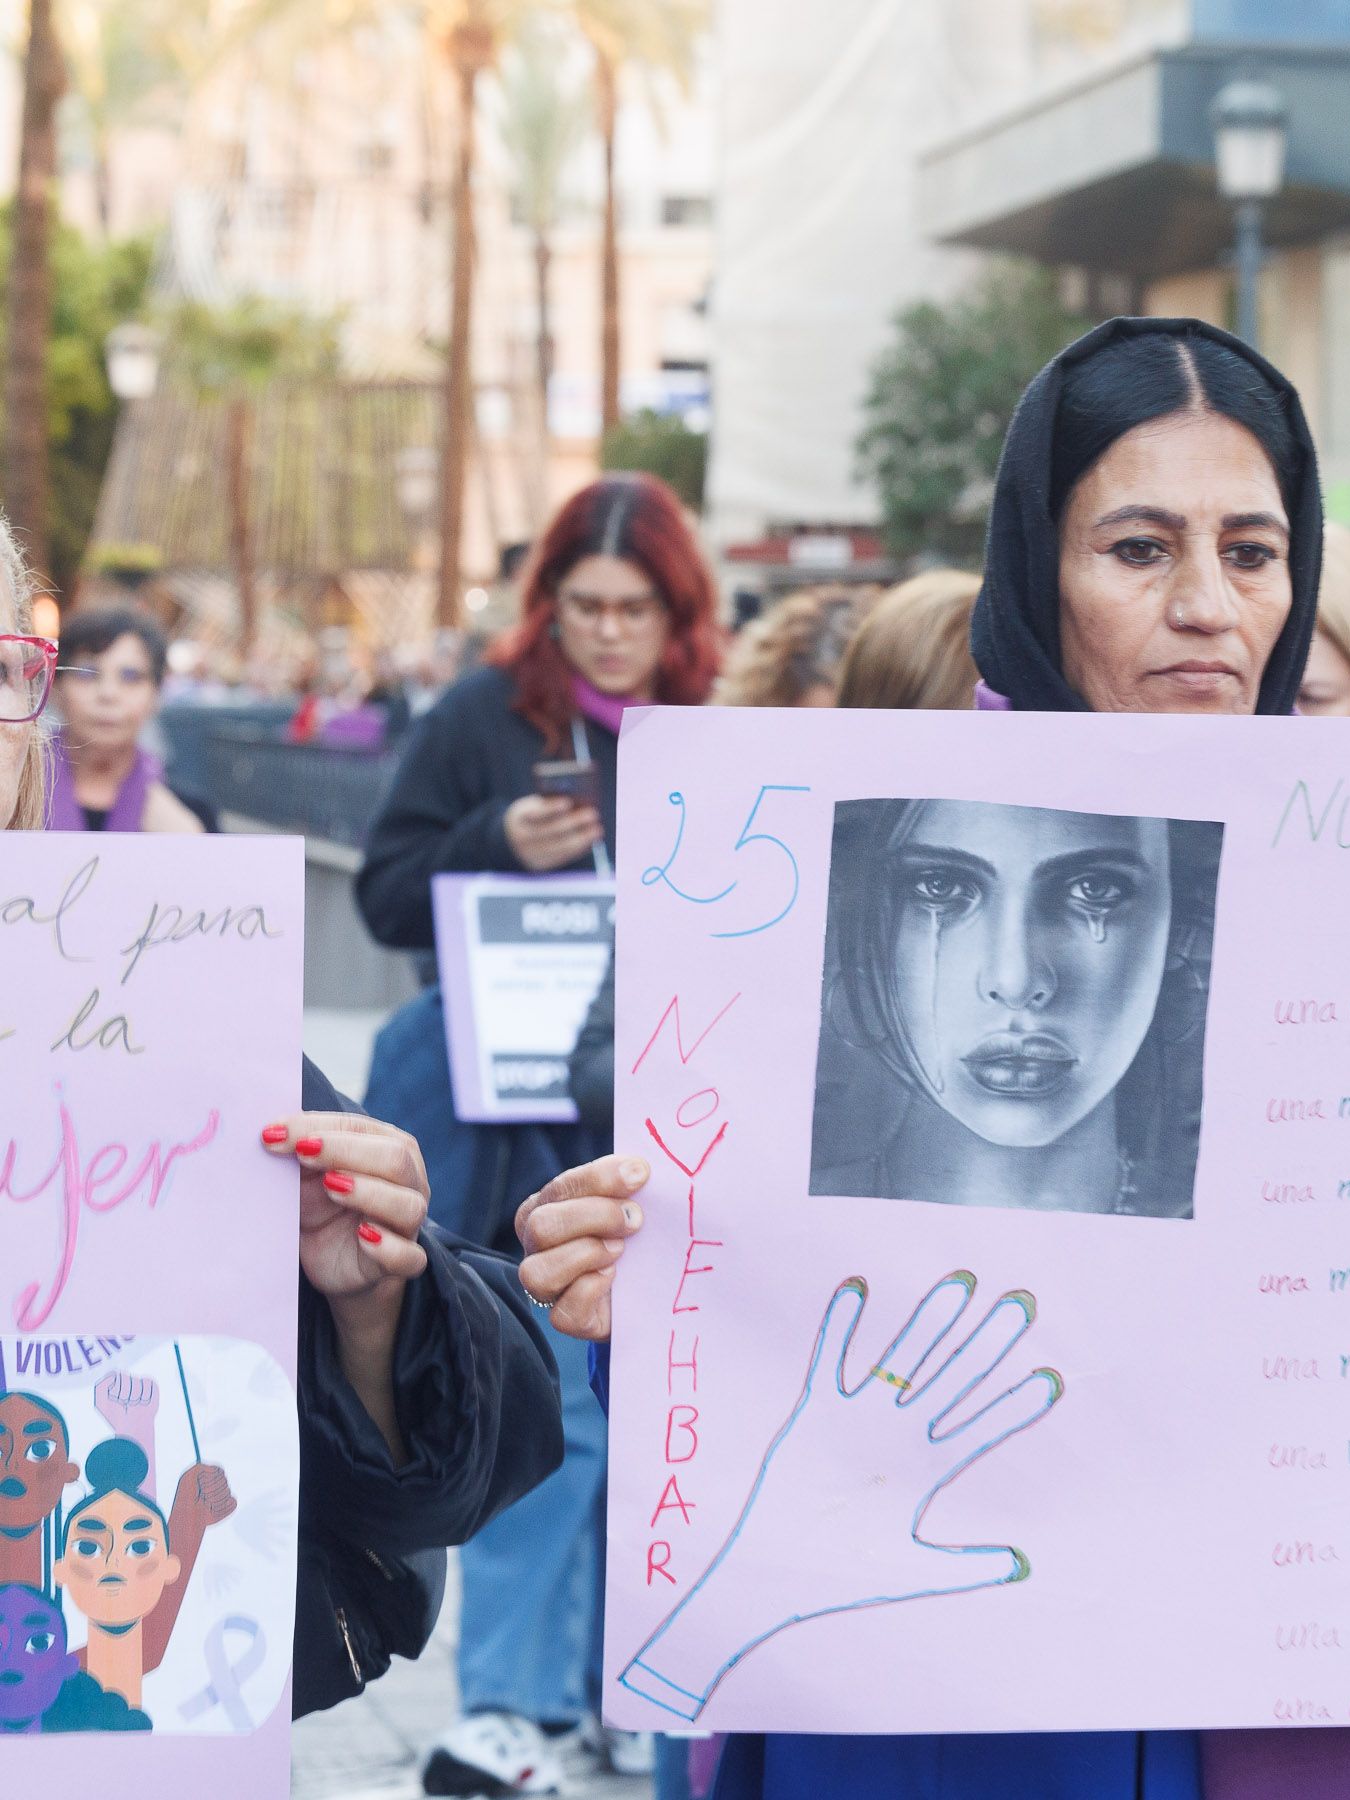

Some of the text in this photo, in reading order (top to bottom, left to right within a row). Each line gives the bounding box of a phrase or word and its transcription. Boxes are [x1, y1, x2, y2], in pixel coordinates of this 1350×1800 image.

[641, 785, 811, 938] 25
[50, 987, 145, 1055] la
[1273, 1000, 1339, 1026] una
[1265, 1095, 1325, 1124] una
[1260, 1176, 1317, 1206] una
[1258, 1270, 1311, 1296] una
[16, 1335, 136, 1375] VIOLEN
[1260, 1353, 1322, 1382] una
[1267, 1443, 1329, 1473] una
[1272, 1538, 1341, 1568] una
[1273, 1620, 1344, 1653] una
[1271, 1695, 1336, 1723] una
